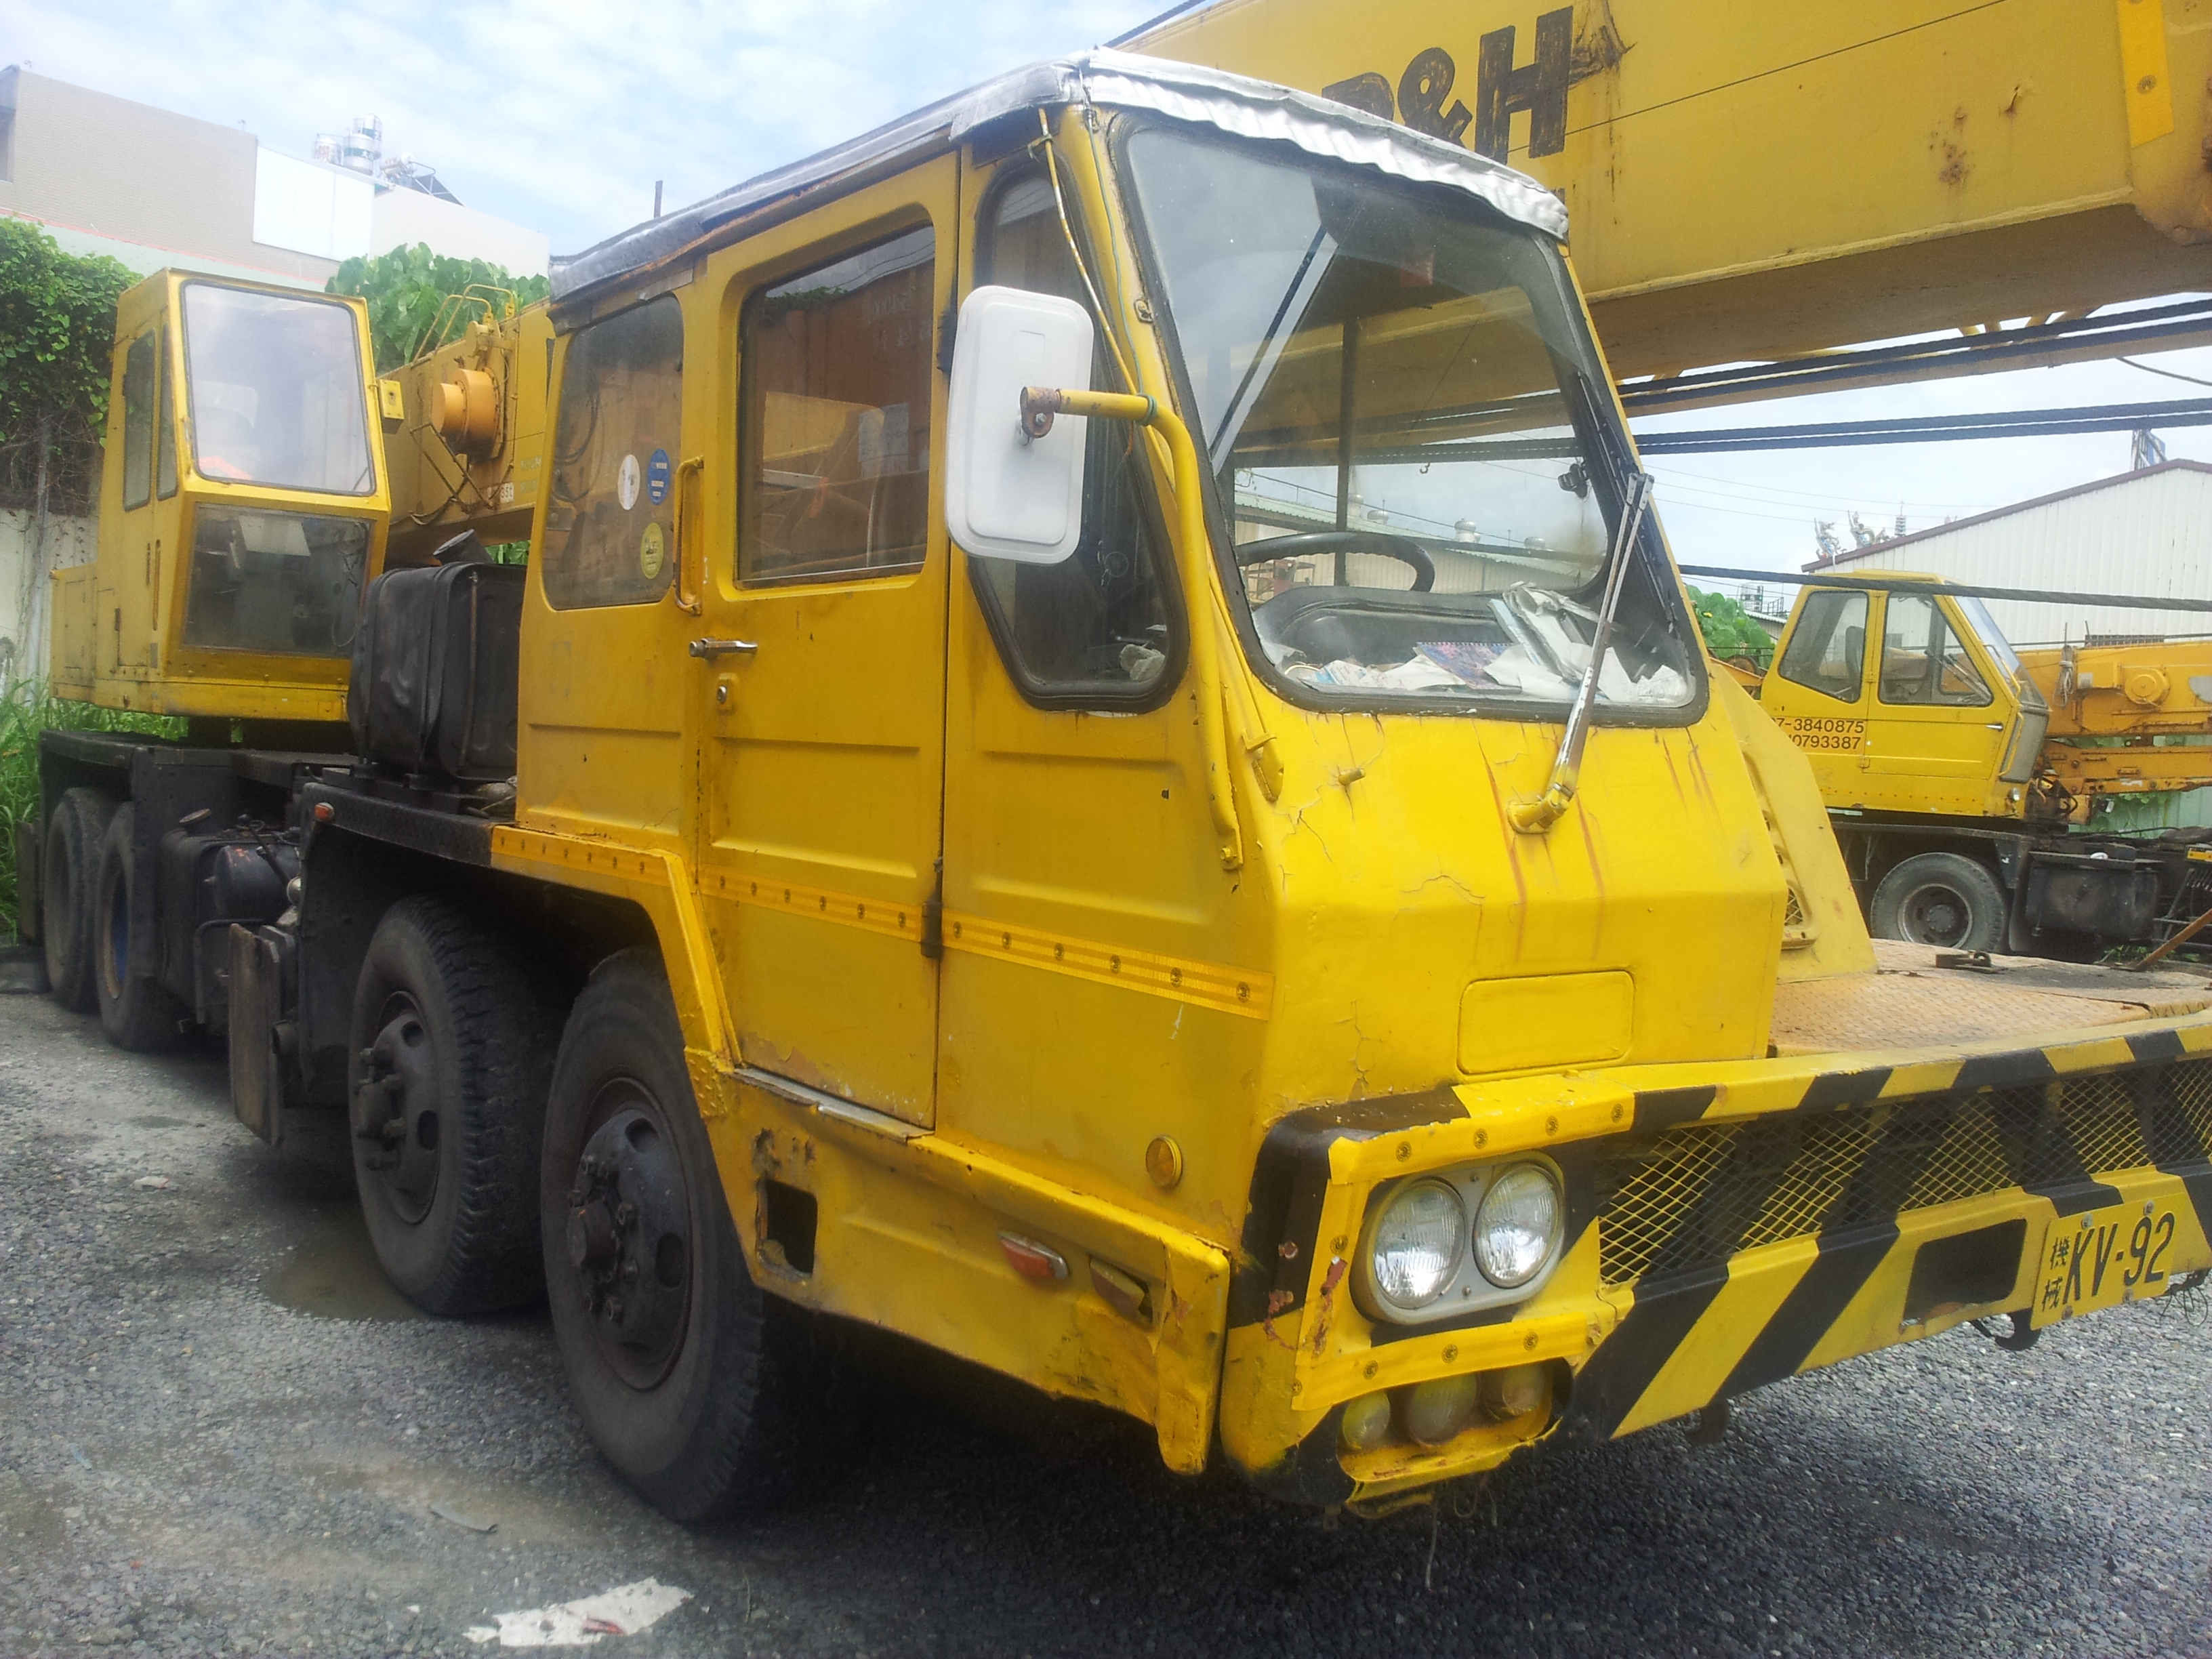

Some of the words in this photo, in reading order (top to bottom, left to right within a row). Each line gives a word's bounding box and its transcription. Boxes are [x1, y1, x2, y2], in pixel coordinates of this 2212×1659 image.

[1771, 717, 1864, 734] 7-3840875
[1788, 734, 1862, 750] 0793387
[2042, 1236, 2070, 1312] 機械
[2063, 1212, 2175, 1305] KV-92
